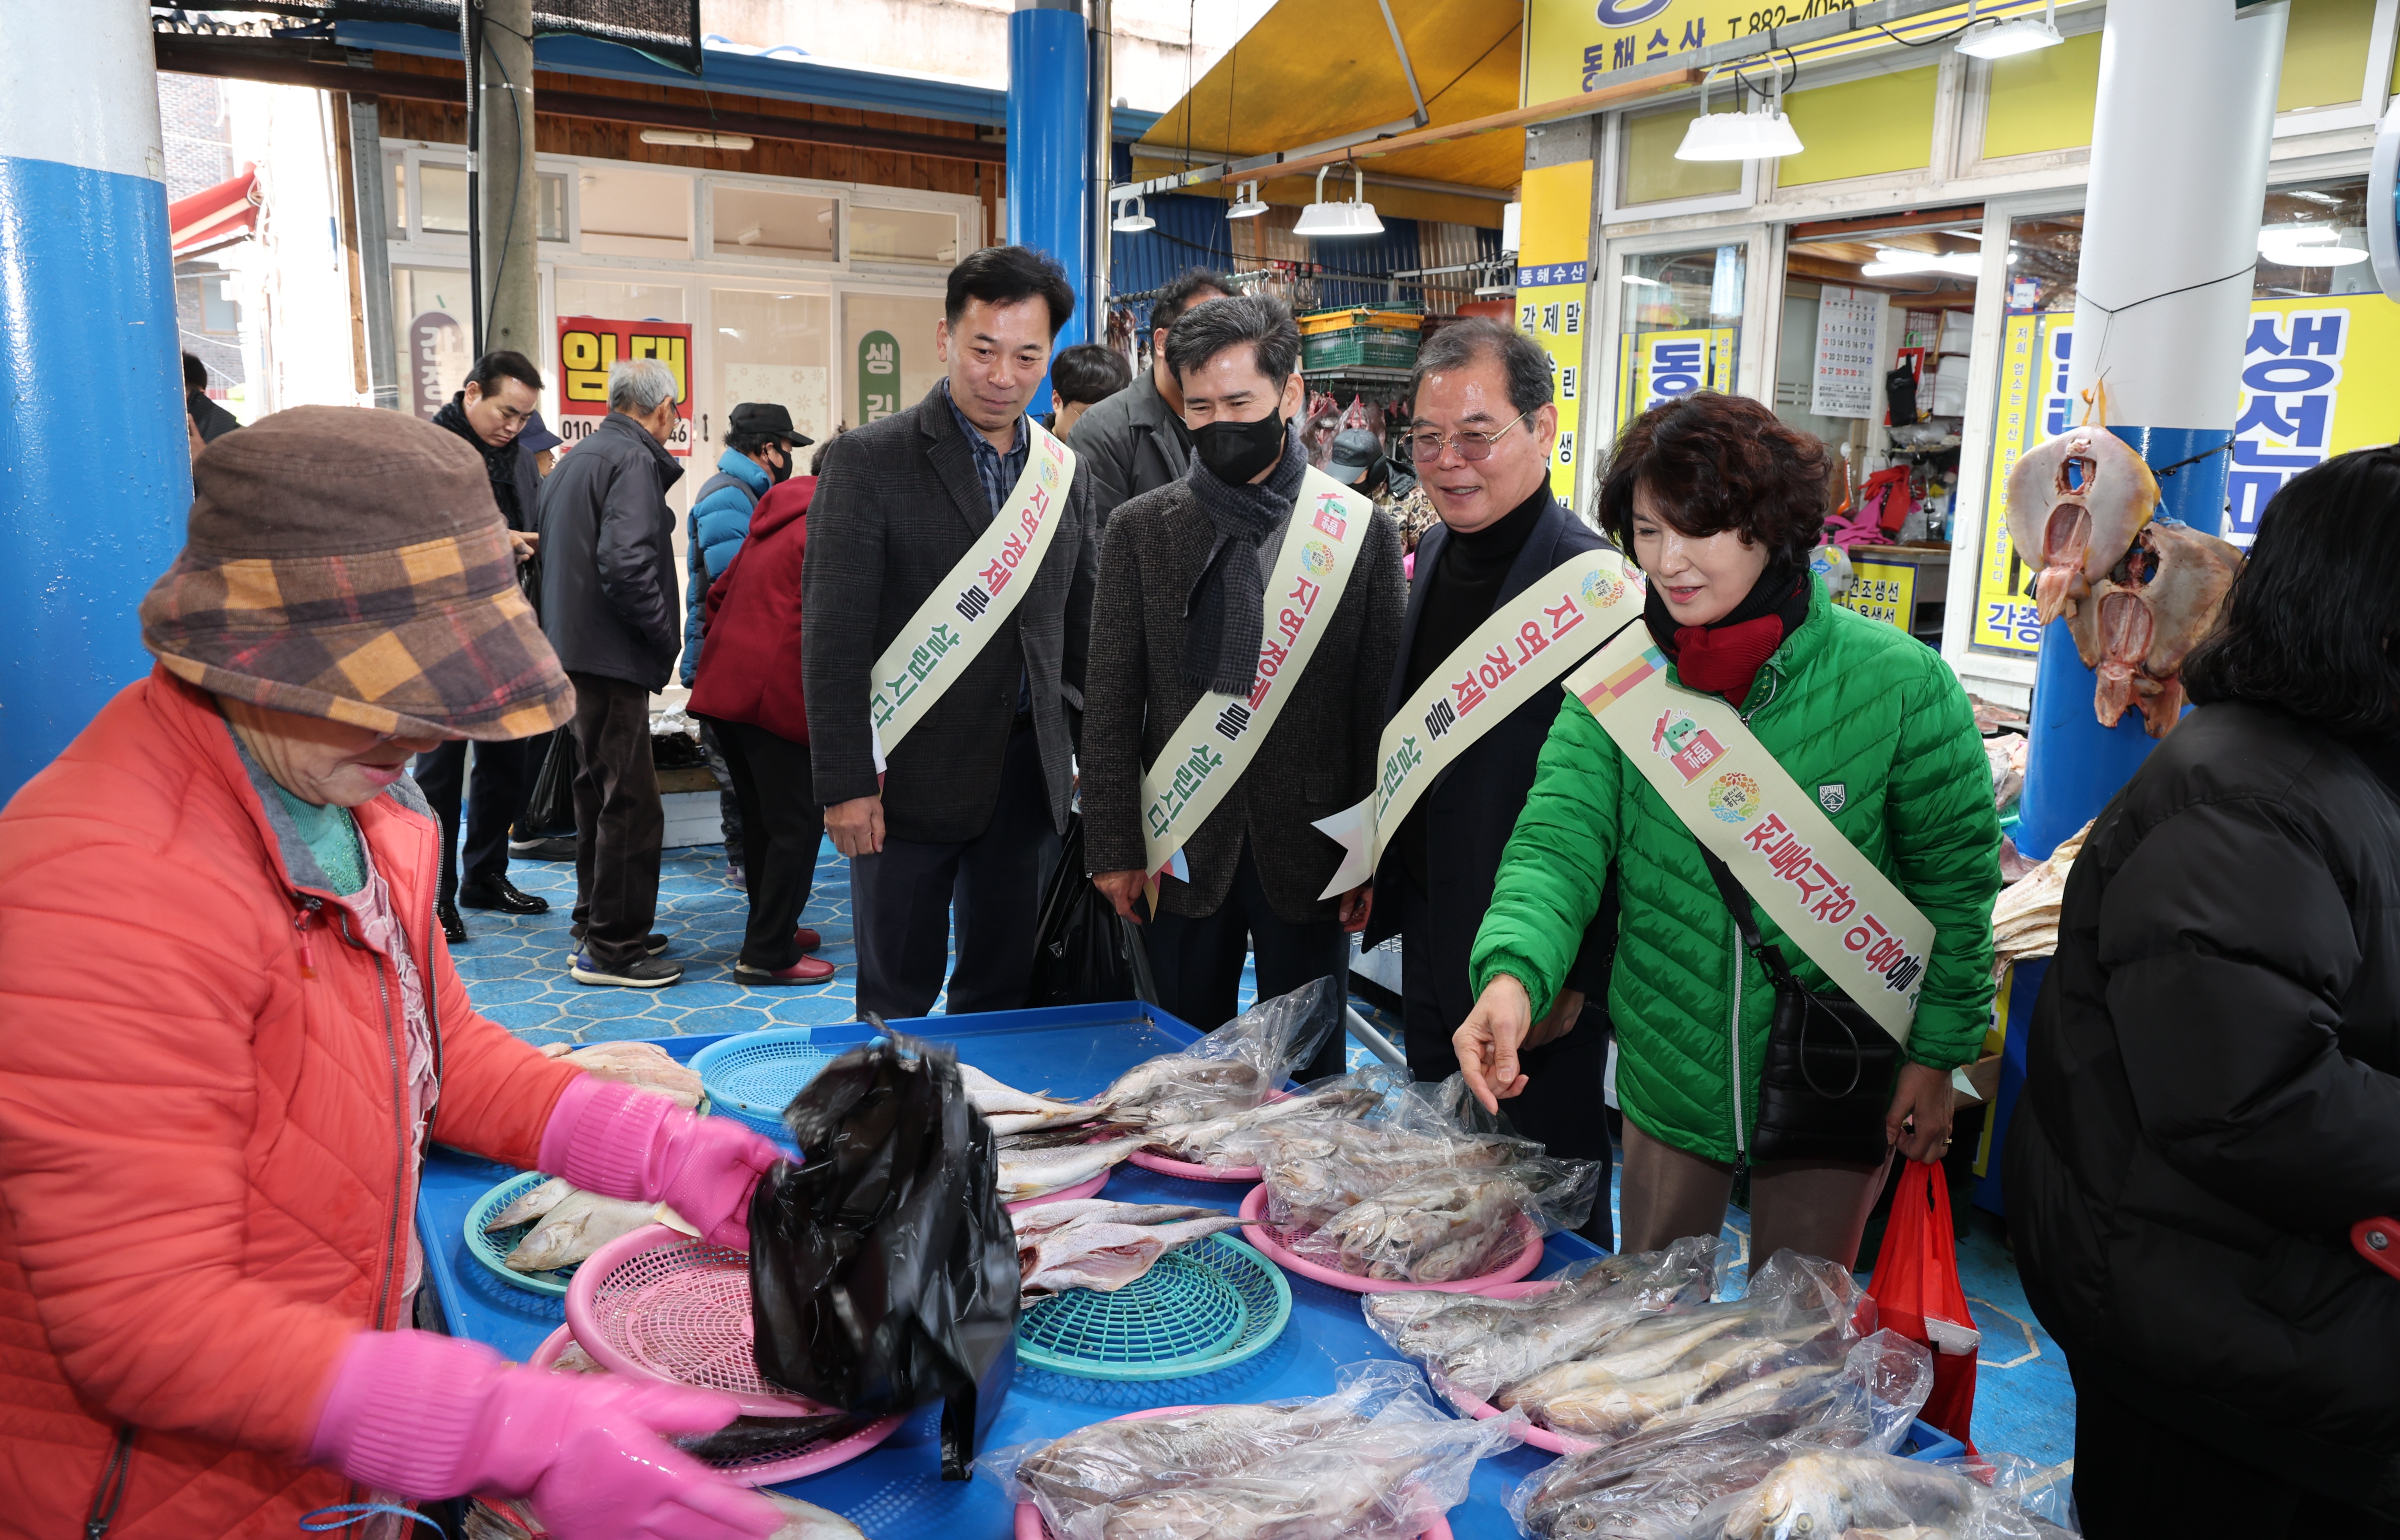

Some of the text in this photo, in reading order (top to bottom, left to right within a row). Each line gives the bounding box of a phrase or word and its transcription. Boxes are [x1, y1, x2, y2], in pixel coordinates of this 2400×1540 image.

[1520, 264, 1584, 286] 동해수산
[1721, 338, 1729, 357] 생선
[2016, 327, 2028, 354] 저희
[2011, 363, 2024, 405] 업소는
[2233, 316, 2341, 467] 생선
[2006, 413, 2019, 441] 국산
[1321, 515, 1339, 536] 福
[1841, 577, 1899, 603] 건조생선
[871, 483, 1051, 730] 지역경제를 살립시다
[1840, 603, 1895, 624] 용생선
[1988, 604, 2041, 643] 각종
[1147, 575, 1319, 839] 지역경제를 살립시다
[1375, 593, 1585, 838] 지역경제를 살립시
[1682, 741, 1714, 769] 福
[1821, 786, 1843, 799] SAEMAUL
[1744, 813, 1922, 992] 전통시장 이용을
